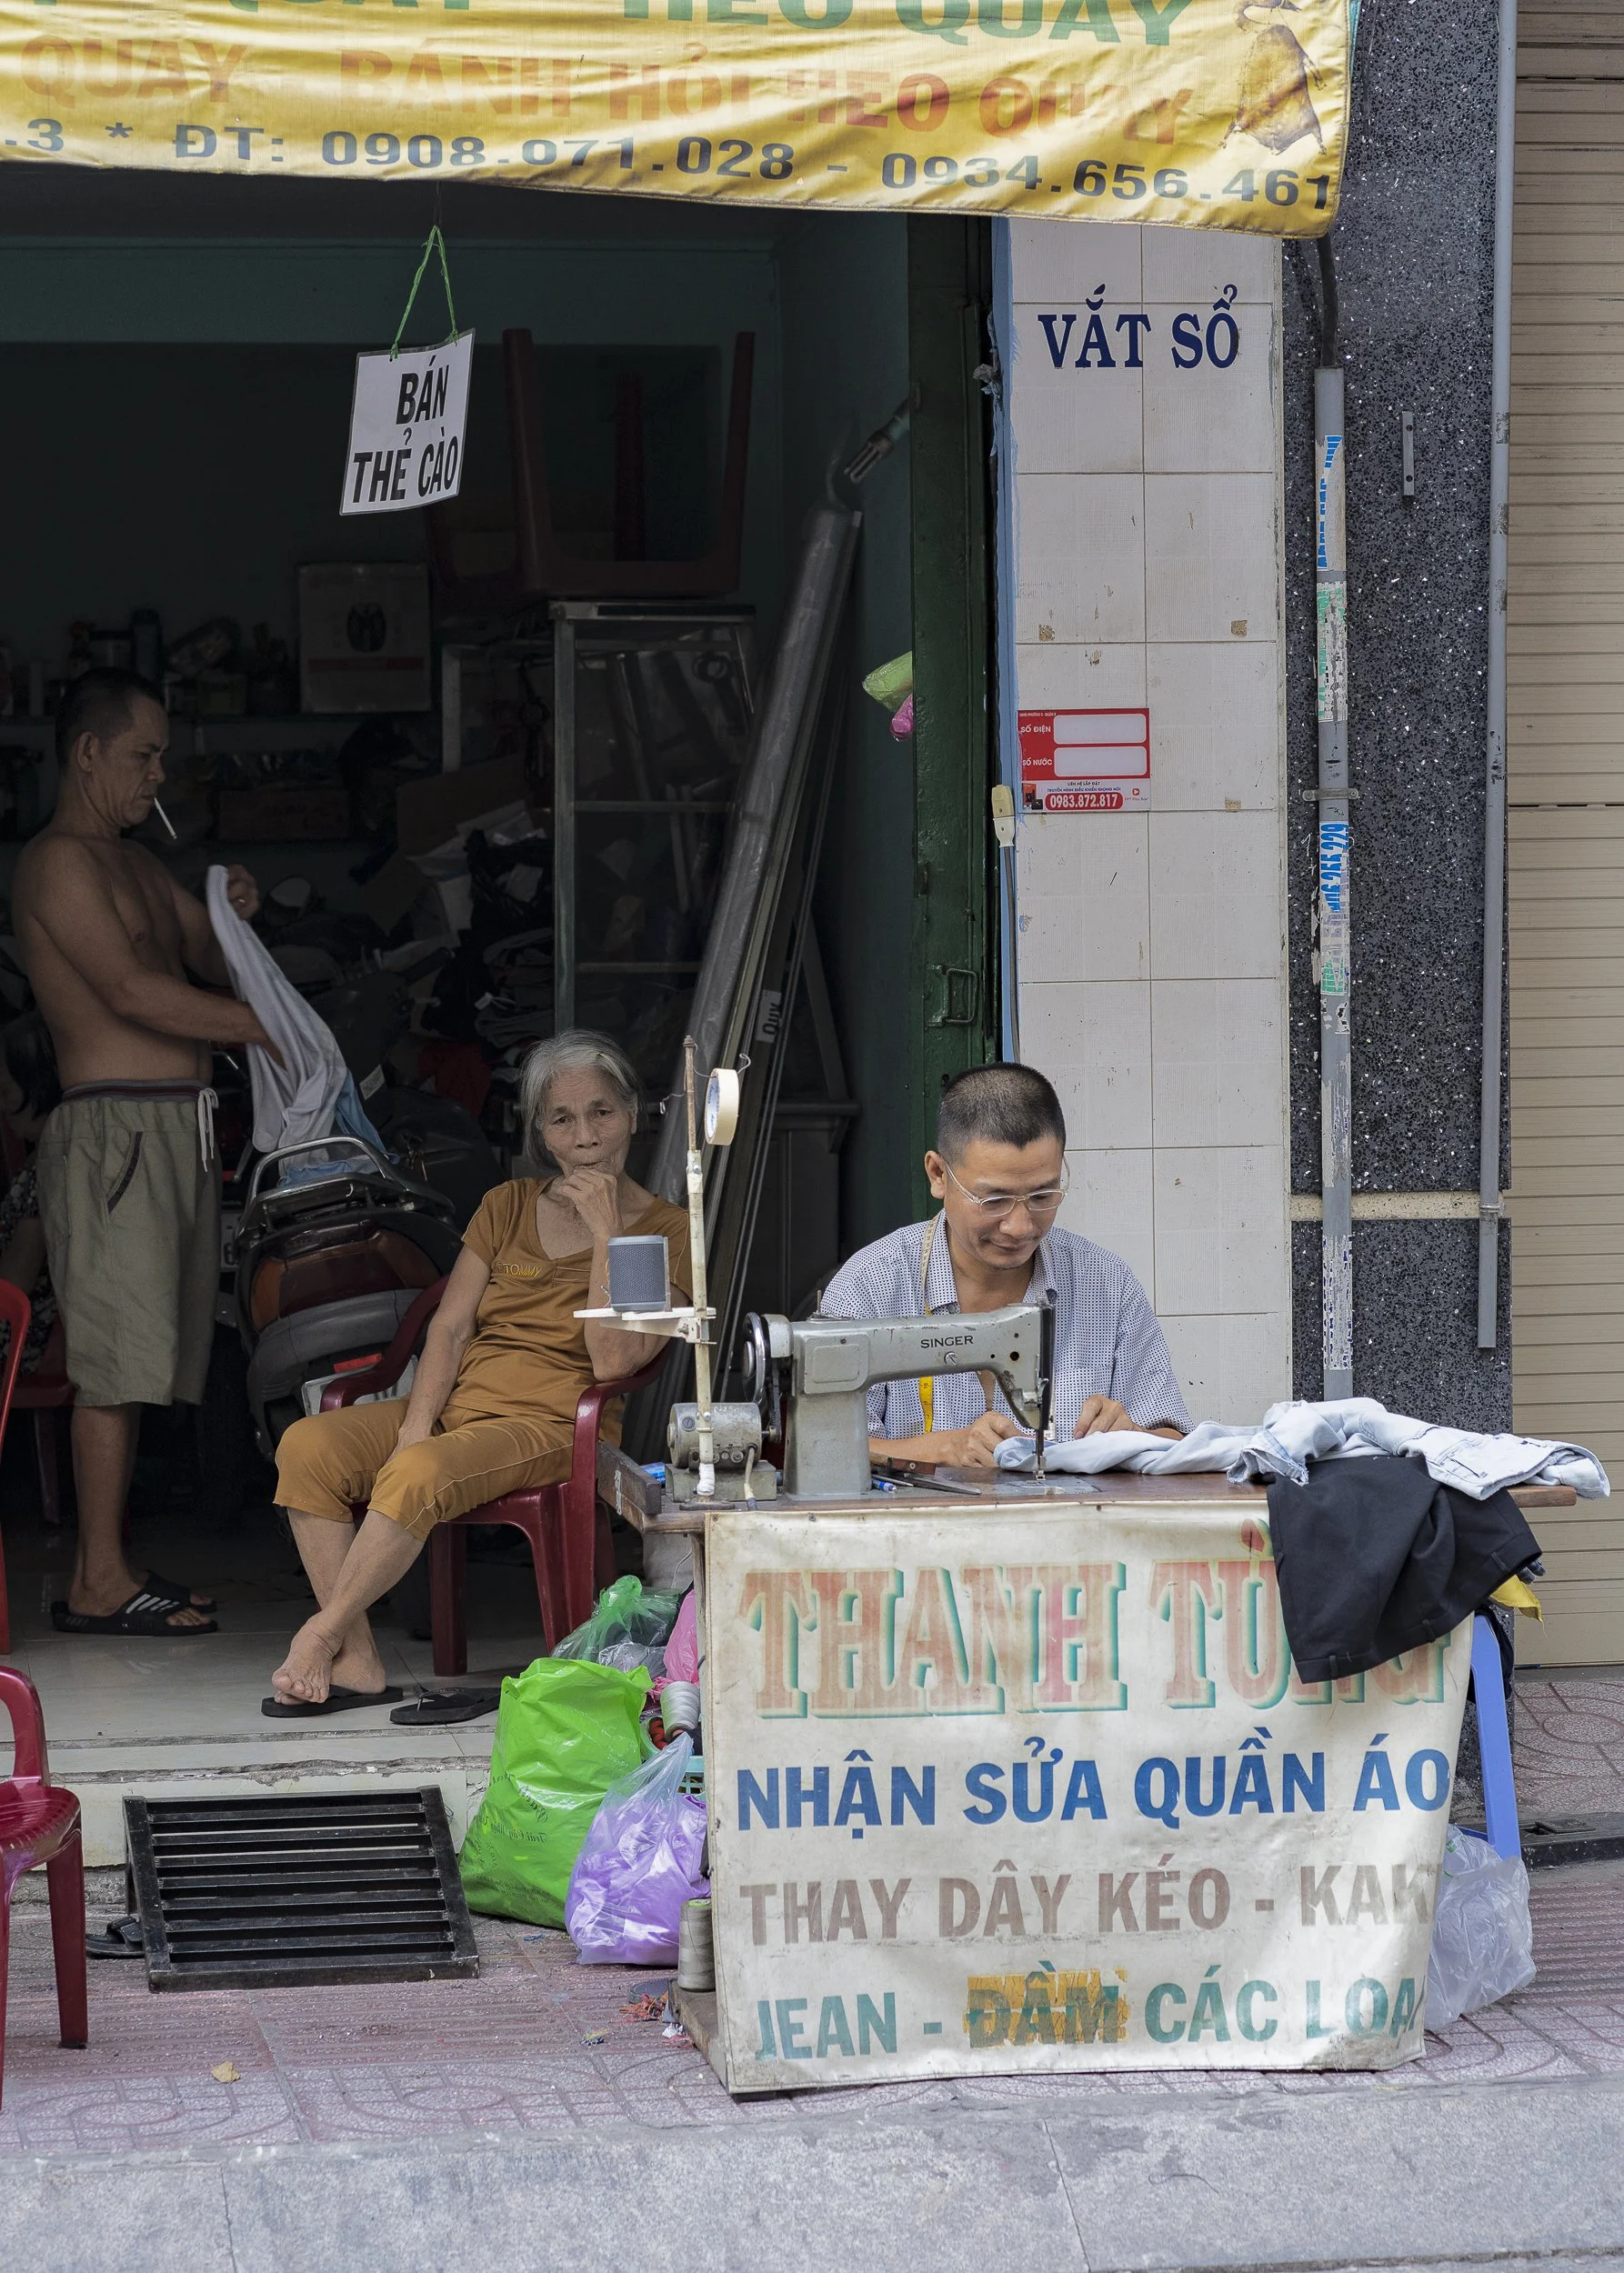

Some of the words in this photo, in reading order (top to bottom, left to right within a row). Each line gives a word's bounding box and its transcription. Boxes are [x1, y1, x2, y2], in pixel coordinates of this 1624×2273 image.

[21, 35, 249, 109] QUAY
[340, 37, 571, 118] BÁNH
[609, 43, 750, 121] HỎI
[787, 69, 950, 133] HEO
[172, 124, 284, 162] ĐT:
[322, 130, 795, 183] 0908.071.028
[882, 151, 1331, 211] 0934.656.461
[1038, 283, 1152, 369] VẮT
[1170, 284, 1239, 369] SỔ
[396, 355, 450, 426] BÁN
[352, 426, 412, 504] THẺ
[417, 426, 458, 497] CÀO
[1020, 724, 1032, 733] SỐ
[1033, 725, 1051, 734] ĐIỆN
[1022, 756, 1032, 766] SỐ
[1033, 757, 1053, 766] NƯỚC
[1049, 794, 1118, 808] 0983.872.817
[502, 1263, 543, 1277] TOMMY
[920, 1335, 974, 1349] SINGER
[738, 1560, 1128, 1719] THANH
[737, 1749, 937, 1839] NHẬN
[964, 1737, 1108, 1826] SỬA
[1134, 1727, 1326, 1829] QUẦN
[1353, 1734, 1450, 1812] ÁO
[739, 1877, 912, 1947] THAY
[938, 1859, 1071, 1938] DÂY
[1098, 1854, 1231, 1933] KÉO
[755, 1991, 898, 2061] JEAN
[1144, 1965, 1278, 2045] CÁC
